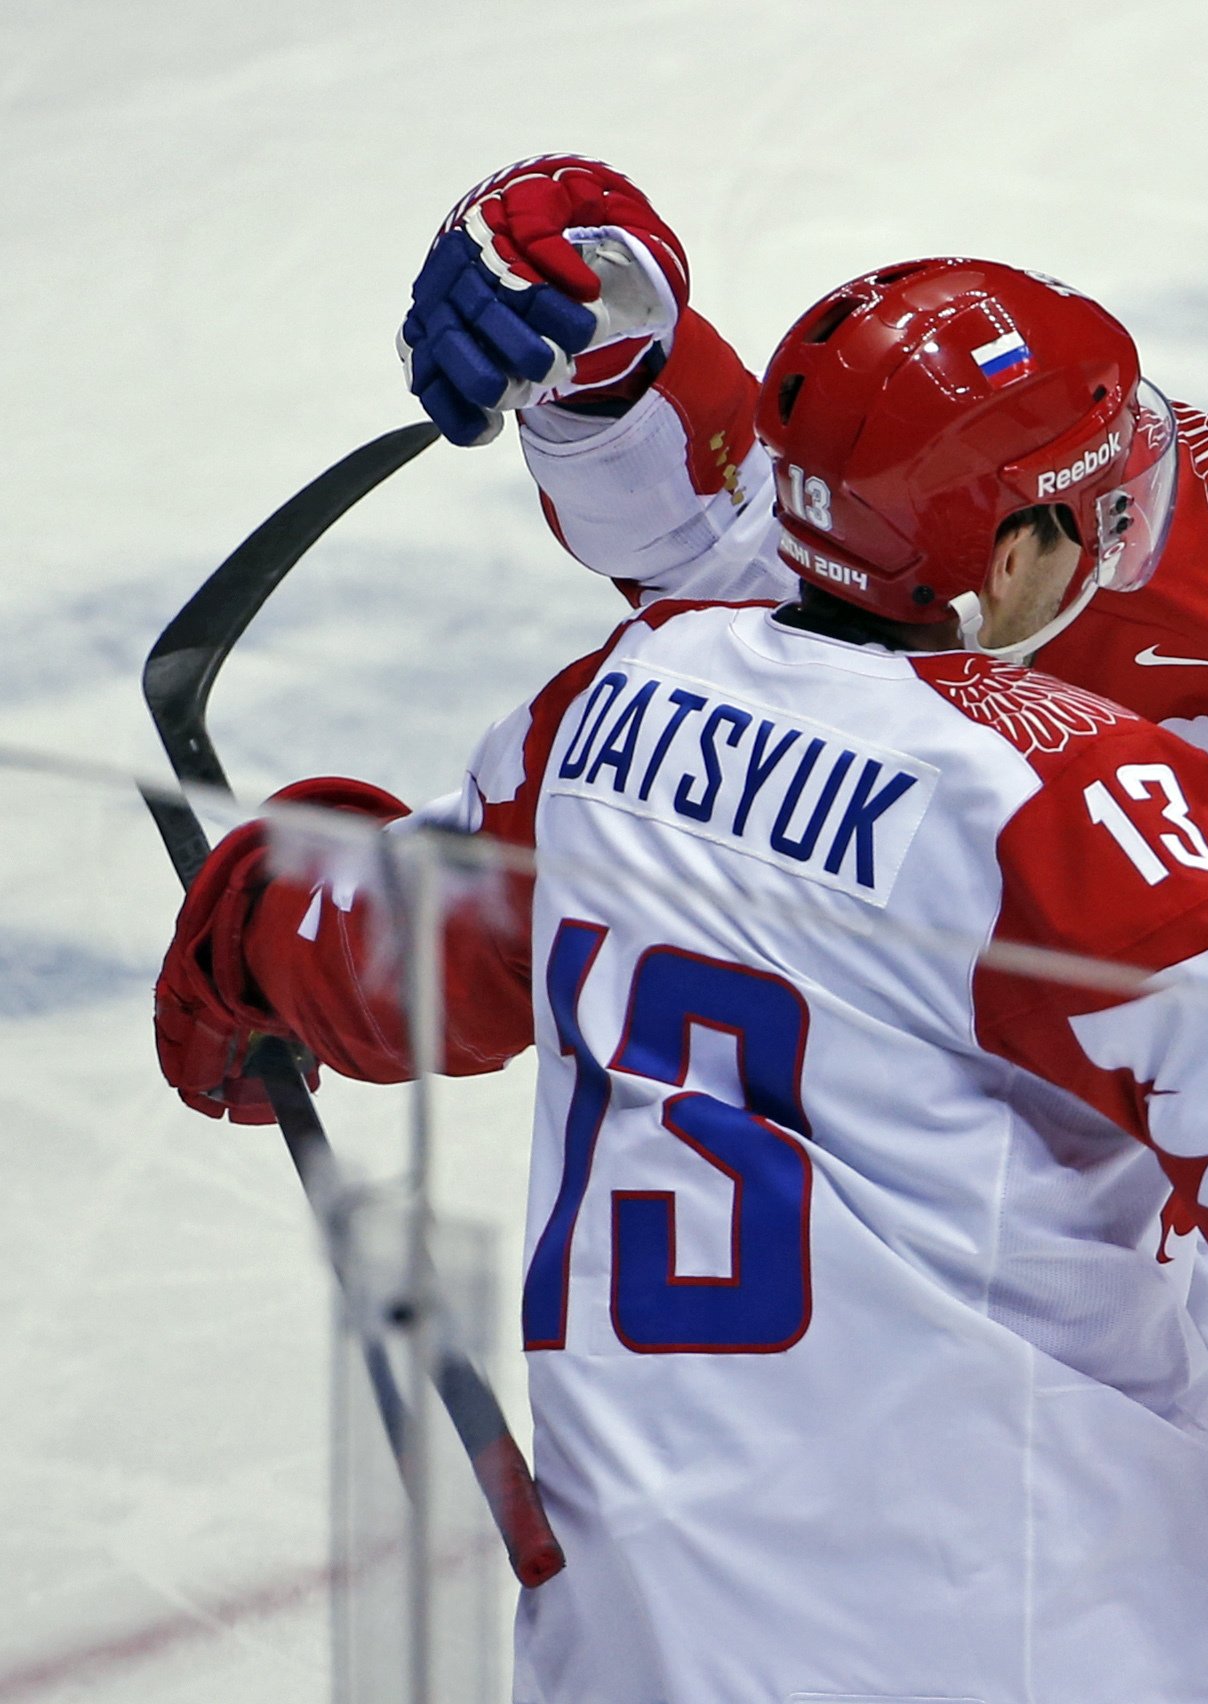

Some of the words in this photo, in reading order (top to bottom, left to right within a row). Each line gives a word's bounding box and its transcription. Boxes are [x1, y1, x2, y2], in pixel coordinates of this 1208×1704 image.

[789, 465, 833, 531] 13
[1037, 430, 1122, 498] Reebok
[813, 554, 869, 591] 2014
[559, 671, 917, 889] DATSYUK
[522, 917, 812, 1354] 13
